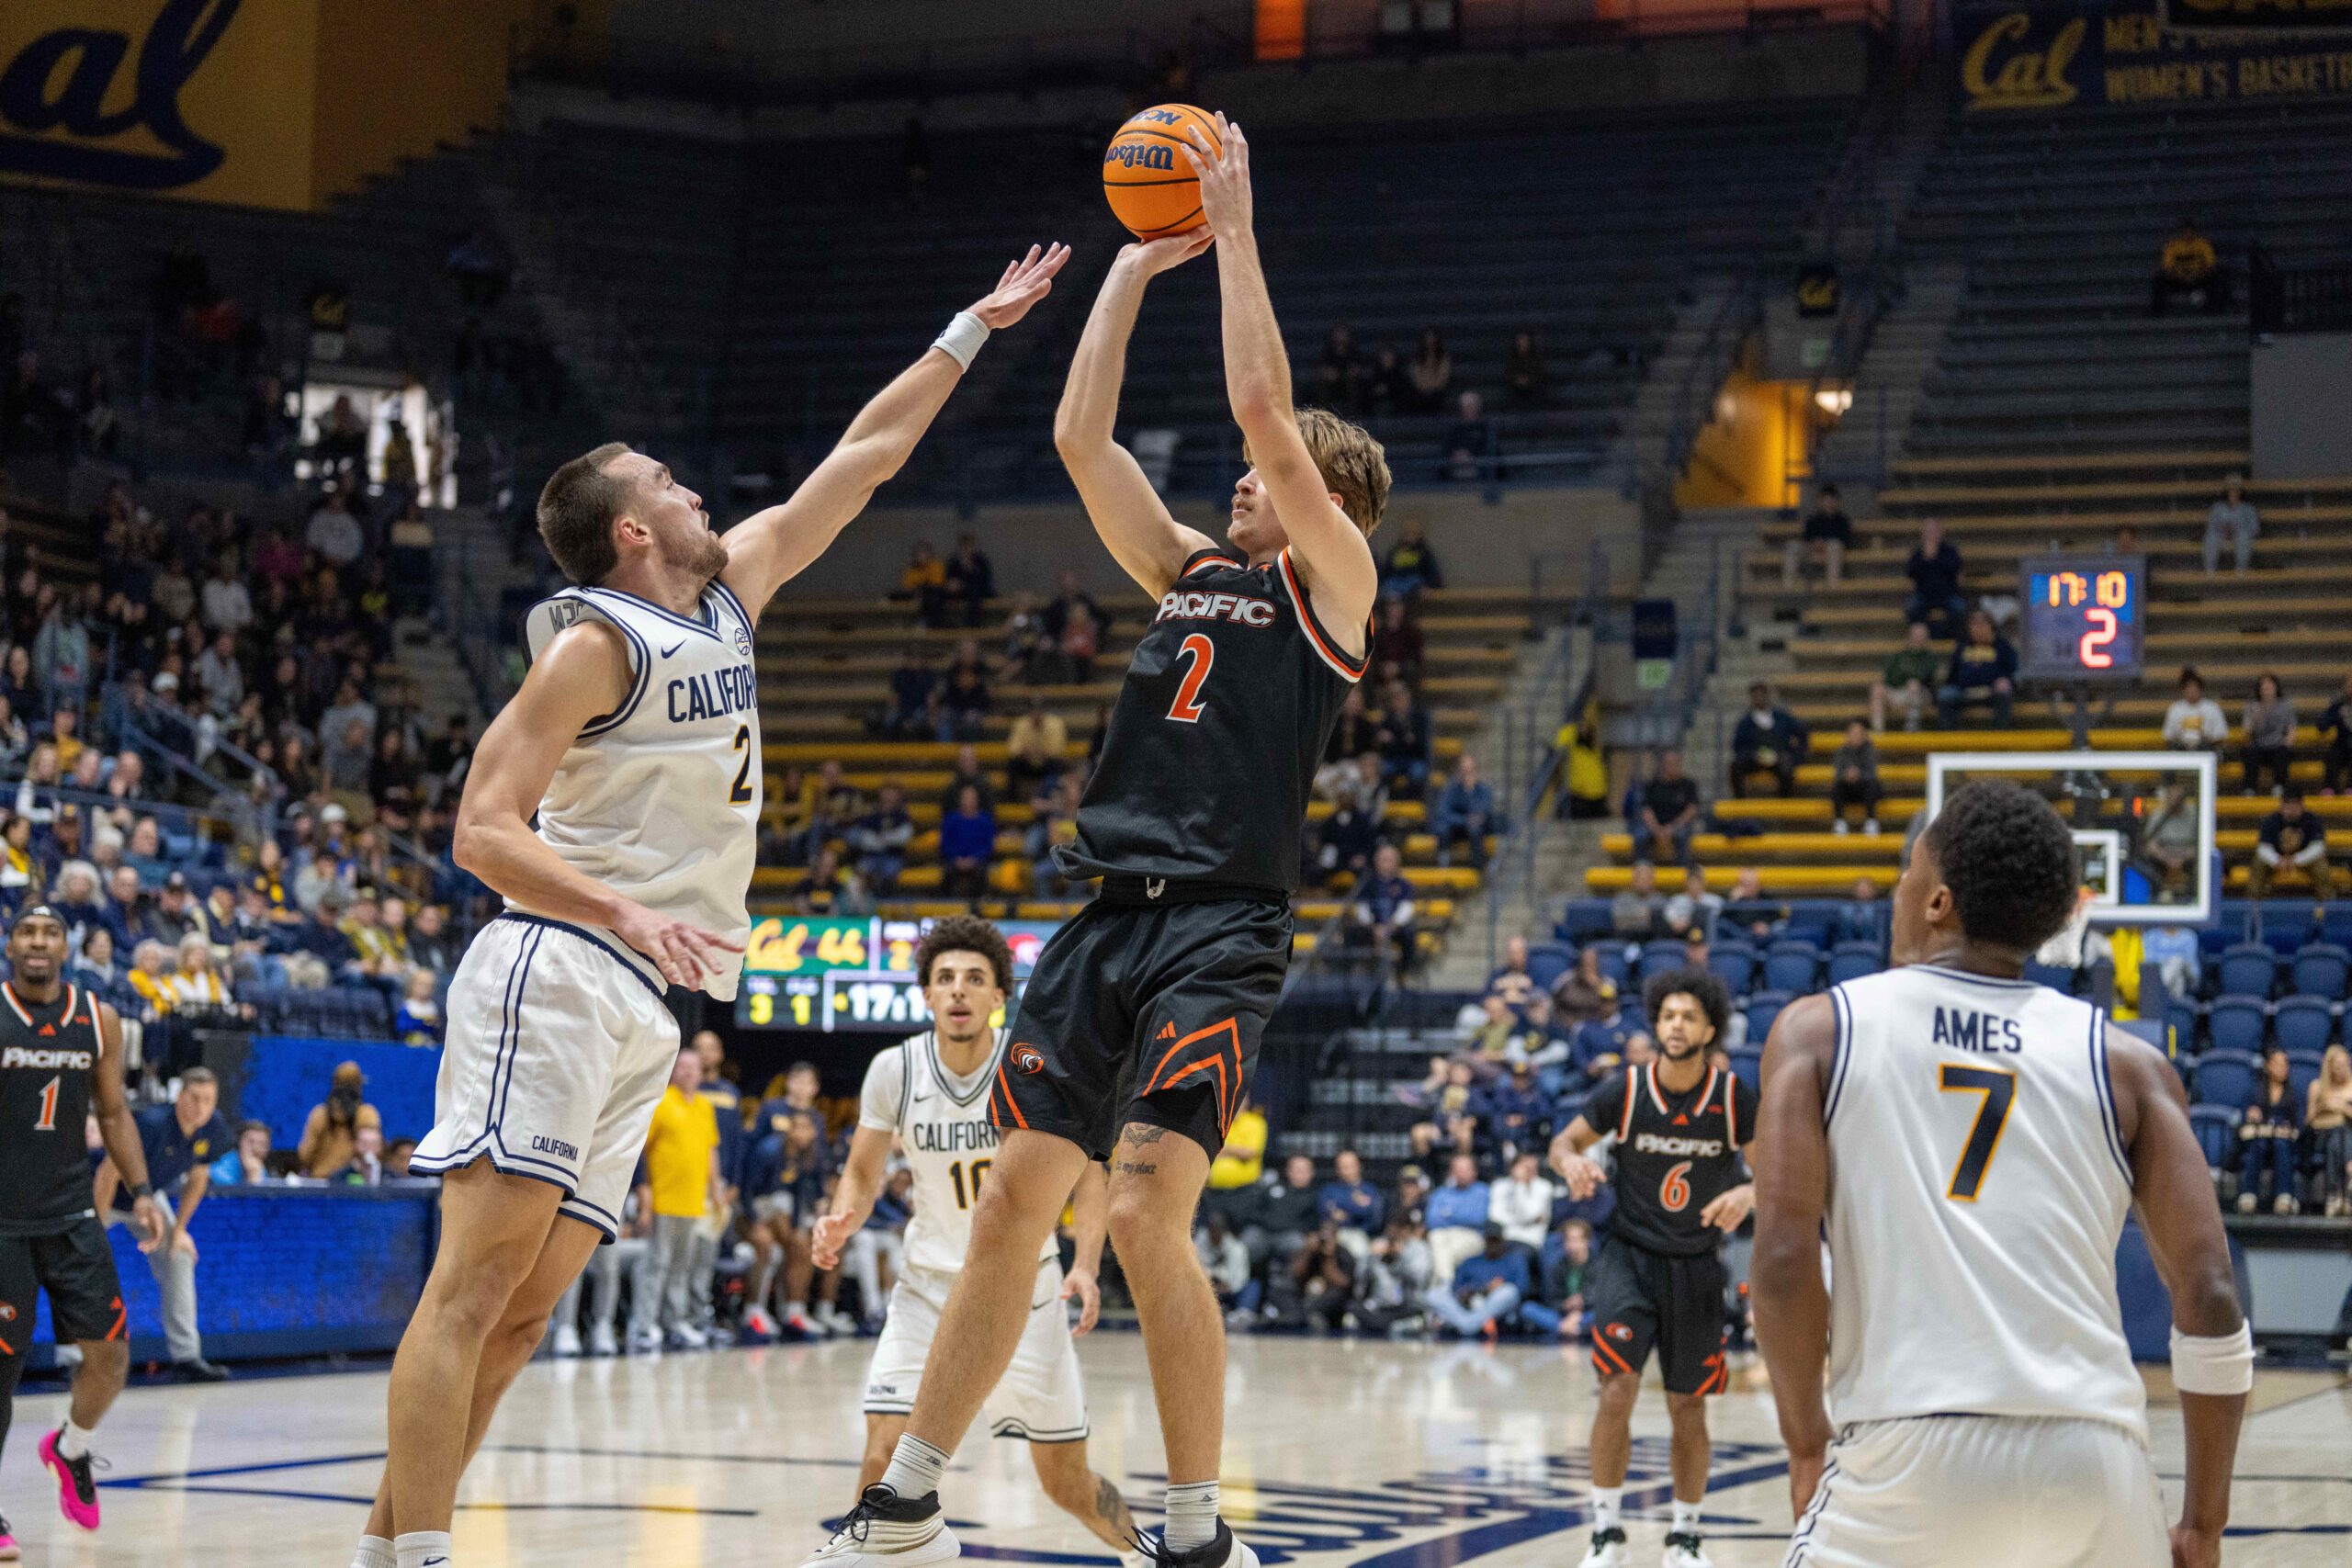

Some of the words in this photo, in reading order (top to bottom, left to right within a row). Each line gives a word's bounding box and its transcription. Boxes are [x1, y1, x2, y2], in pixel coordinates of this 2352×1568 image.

[2103, 14, 2188, 51] MEN
[1962, 13, 2086, 111] Cal
[0, 0, 241, 189] al
[1105, 143, 1173, 170] Wilson
[1155, 590, 1275, 628] PACIFIC
[2048, 570, 2127, 608] 17:10
[2080, 607, 2117, 669] 2
[667, 663, 758, 723] CALIFOR
[1165, 633, 1215, 723] 2
[729, 725, 752, 805] 2
[746, 918, 808, 971] Cal
[750, 993, 773, 1025] 3
[847, 983, 934, 1021] 17:1
[1932, 1005, 2022, 1055] AMES
[1, 1046, 93, 1069] PACIFIC
[33, 1075, 61, 1131] 1
[532, 1135, 578, 1161] CALIFORNIA
[1634, 1133, 1724, 1157] PACIFIC
[1939, 1064, 2017, 1202] 7
[1658, 1160, 1692, 1213] 6
